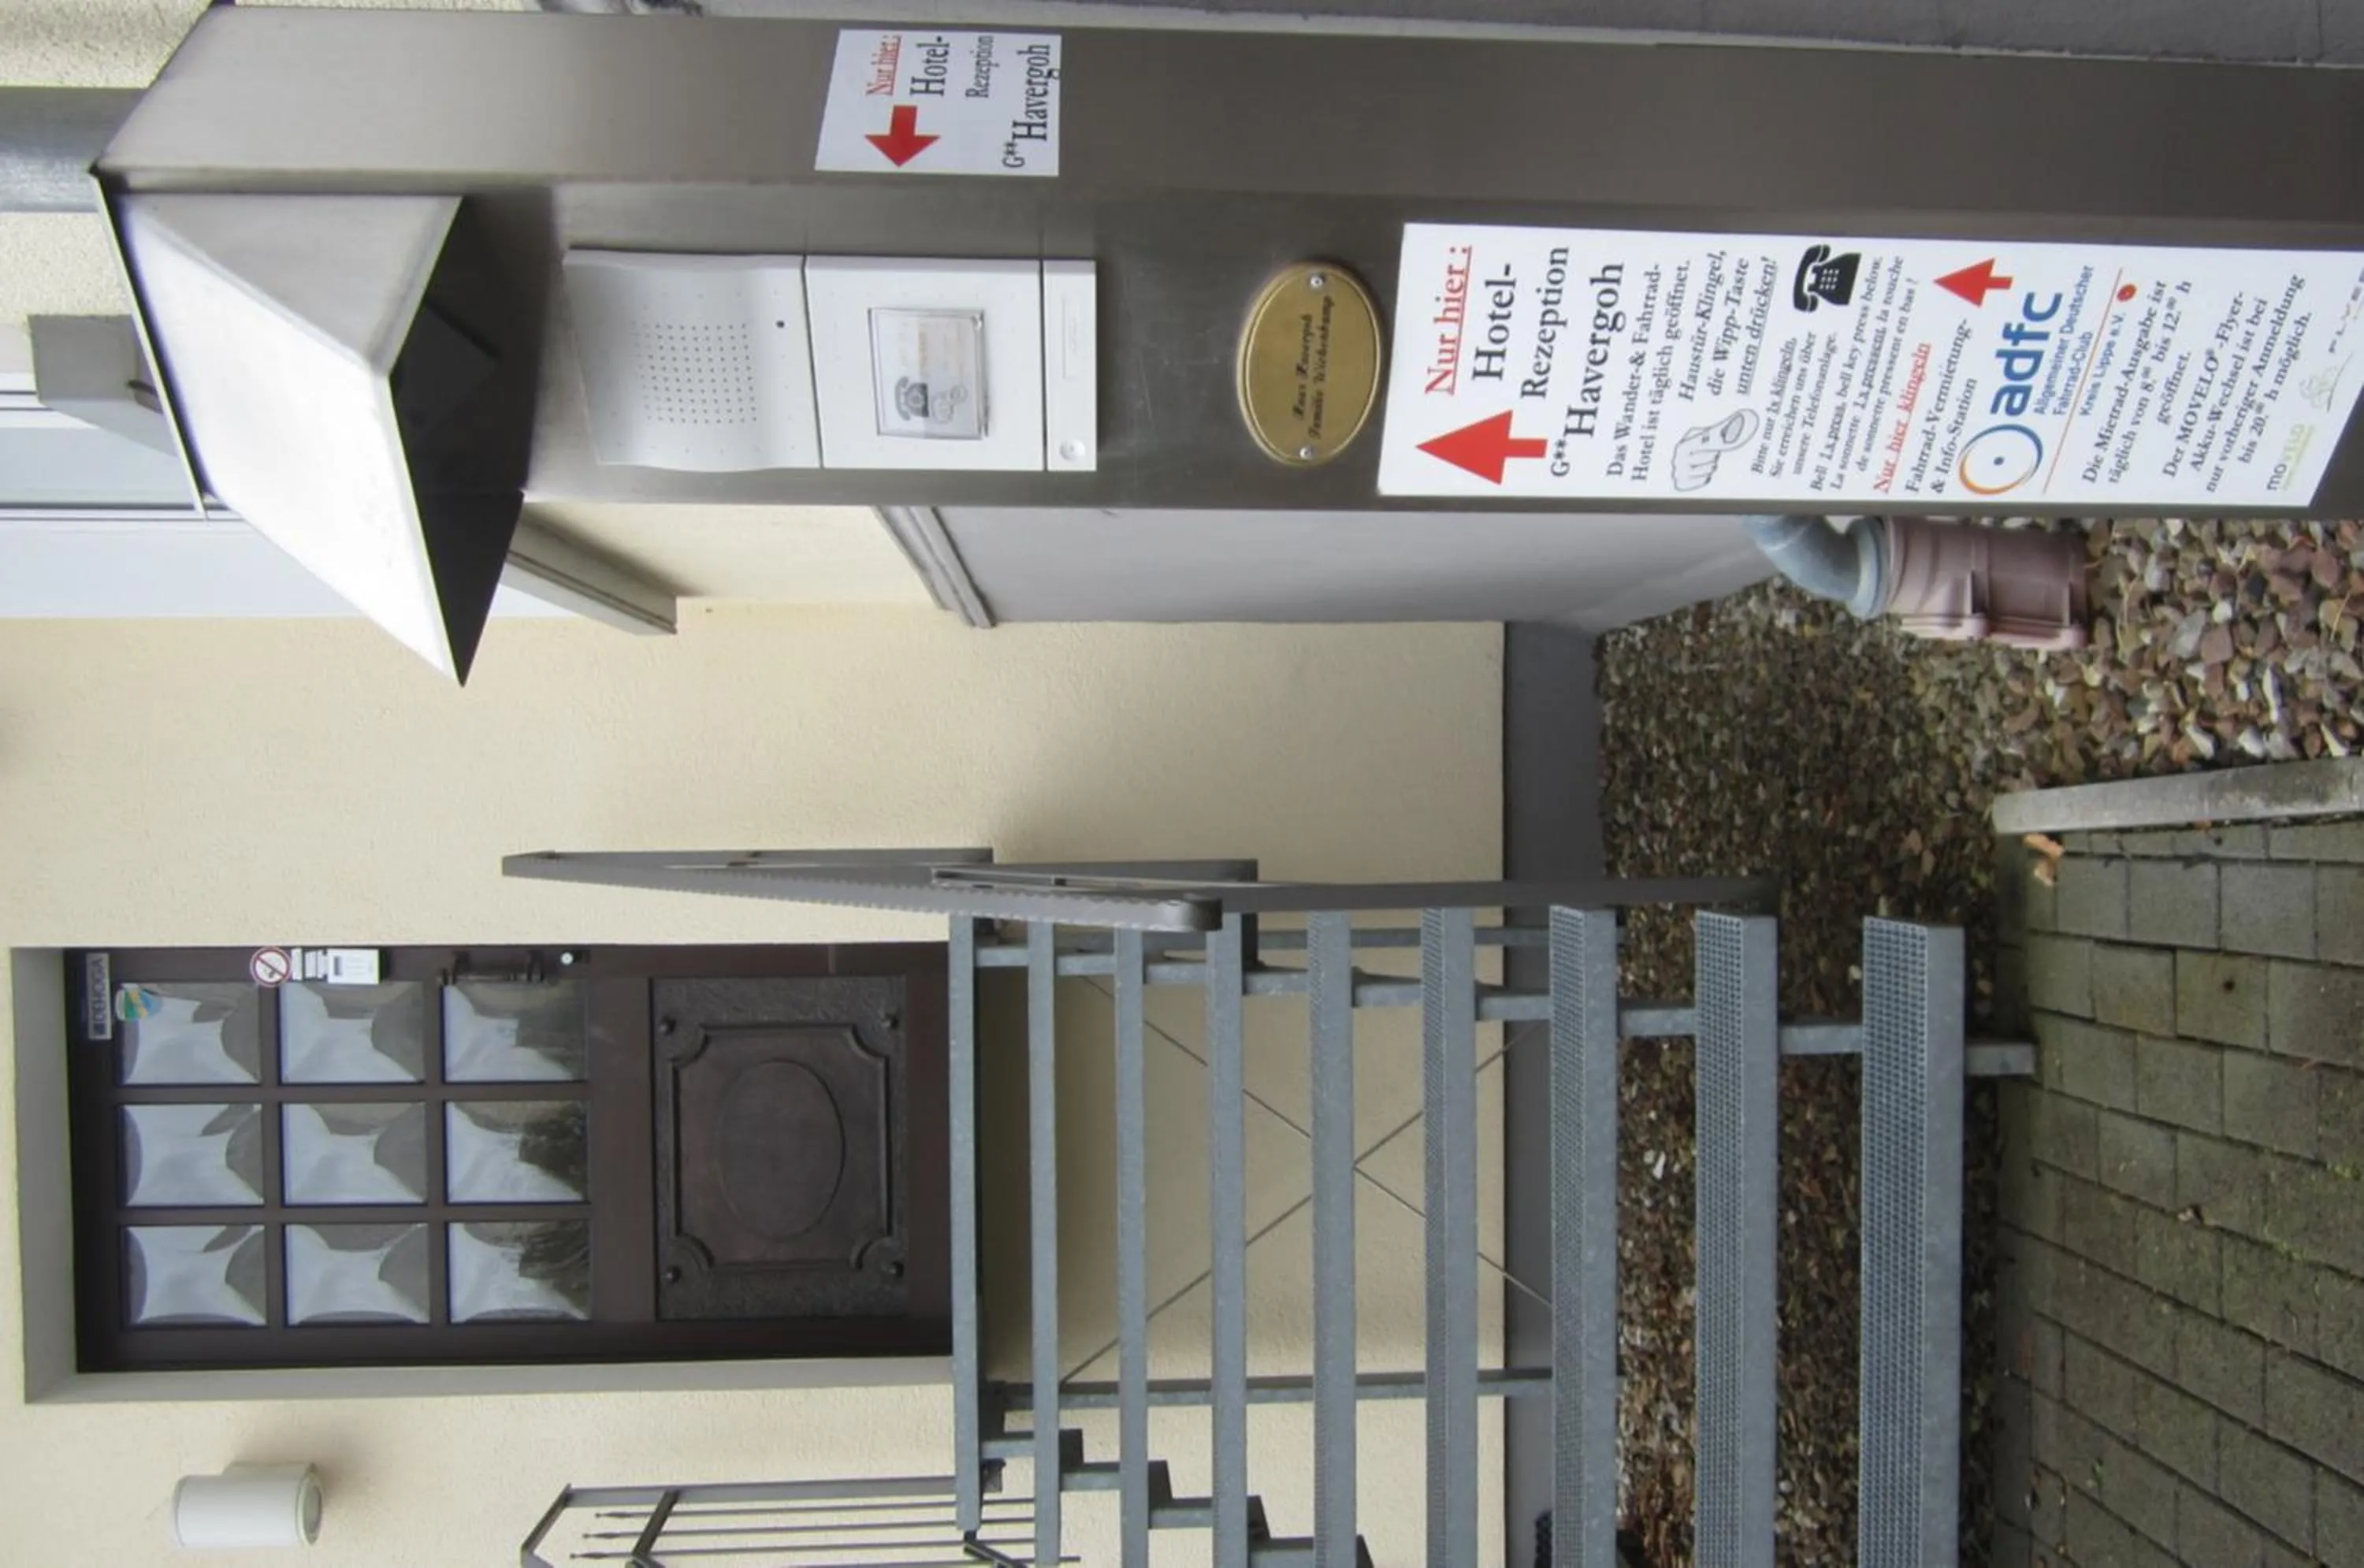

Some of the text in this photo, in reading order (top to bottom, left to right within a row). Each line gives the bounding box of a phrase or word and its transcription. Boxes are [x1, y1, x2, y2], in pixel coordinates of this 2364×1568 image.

[865, 69, 893, 96] Nur
[909, 35, 949, 96] Hotel-
[965, 35, 998, 98] Rezeption
[1471, 263, 1516, 381] Hotel-
[1520, 247, 1568, 399] Rezeption
[1678, 250, 1727, 401] Haustür-Klingel,
[1706, 258, 1749, 396] die Wipp-Taste
[1736, 255, 1779, 395] unten drücken!
[1853, 306, 1869, 343] press
[1897, 316, 1909, 334] en
[1898, 288, 1916, 314] bas
[2033, 266, 2095, 414] Allgemeiner Deutscher
[1425, 334, 1457, 394] Nur
[1607, 445, 1626, 476] Das
[1631, 265, 1661, 344] Fahrrad-
[1631, 260, 1690, 481] Hotel ist täglich geöffnet.
[1769, 332, 1816, 477] Sie erreichen uns über
[1793, 333, 1837, 474] unsere Telefonanlage.
[1830, 473, 1845, 489] La
[1839, 416, 1860, 470] sonnette
[1875, 310, 1890, 322] la
[1883, 257, 1904, 305] touche
[1835, 371, 1852, 397] bell
[1842, 347, 1861, 369] key
[1879, 337, 1904, 396] pressent
[1989, 292, 2063, 417] adfc
[2052, 331, 2094, 415] Fahrrad-Club
[2079, 381, 2101, 416] Kreis
[2093, 340, 2116, 378] Lippe
[2082, 280, 2166, 484] Die Mietrad-Ausgabe ist
[2108, 430, 2137, 484] täglich
[2130, 396, 2150, 425] von
[2150, 337, 2171, 362] bis
[2175, 281, 2192, 294] h
[2156, 351, 2191, 425] geöffnet.
[2189, 297, 2269, 472] Akku-Wechsel ist bei
[2206, 465, 2225, 493] nur
[2218, 380, 2259, 462] vorheriger
[2251, 274, 2306, 377] Anmeldung
[2236, 440, 2258, 463] bis
[2263, 388, 2280, 401] h
[2273, 311, 2313, 386] möglich.
[1763, 418, 1775, 440] nur
[1765, 402, 1781, 414] 1x
[1864, 398, 1885, 452] sonnette
[1873, 343, 1931, 494] Nur hier klingeln
[1905, 318, 1972, 492] Fahrrad-Vermietung-
[1930, 377, 1977, 493] & Info-Station
[1751, 444, 1769, 474] Bitte
[1810, 465, 1827, 491] Bell
[1855, 455, 1868, 472] de
[2161, 447, 2185, 477] Der
